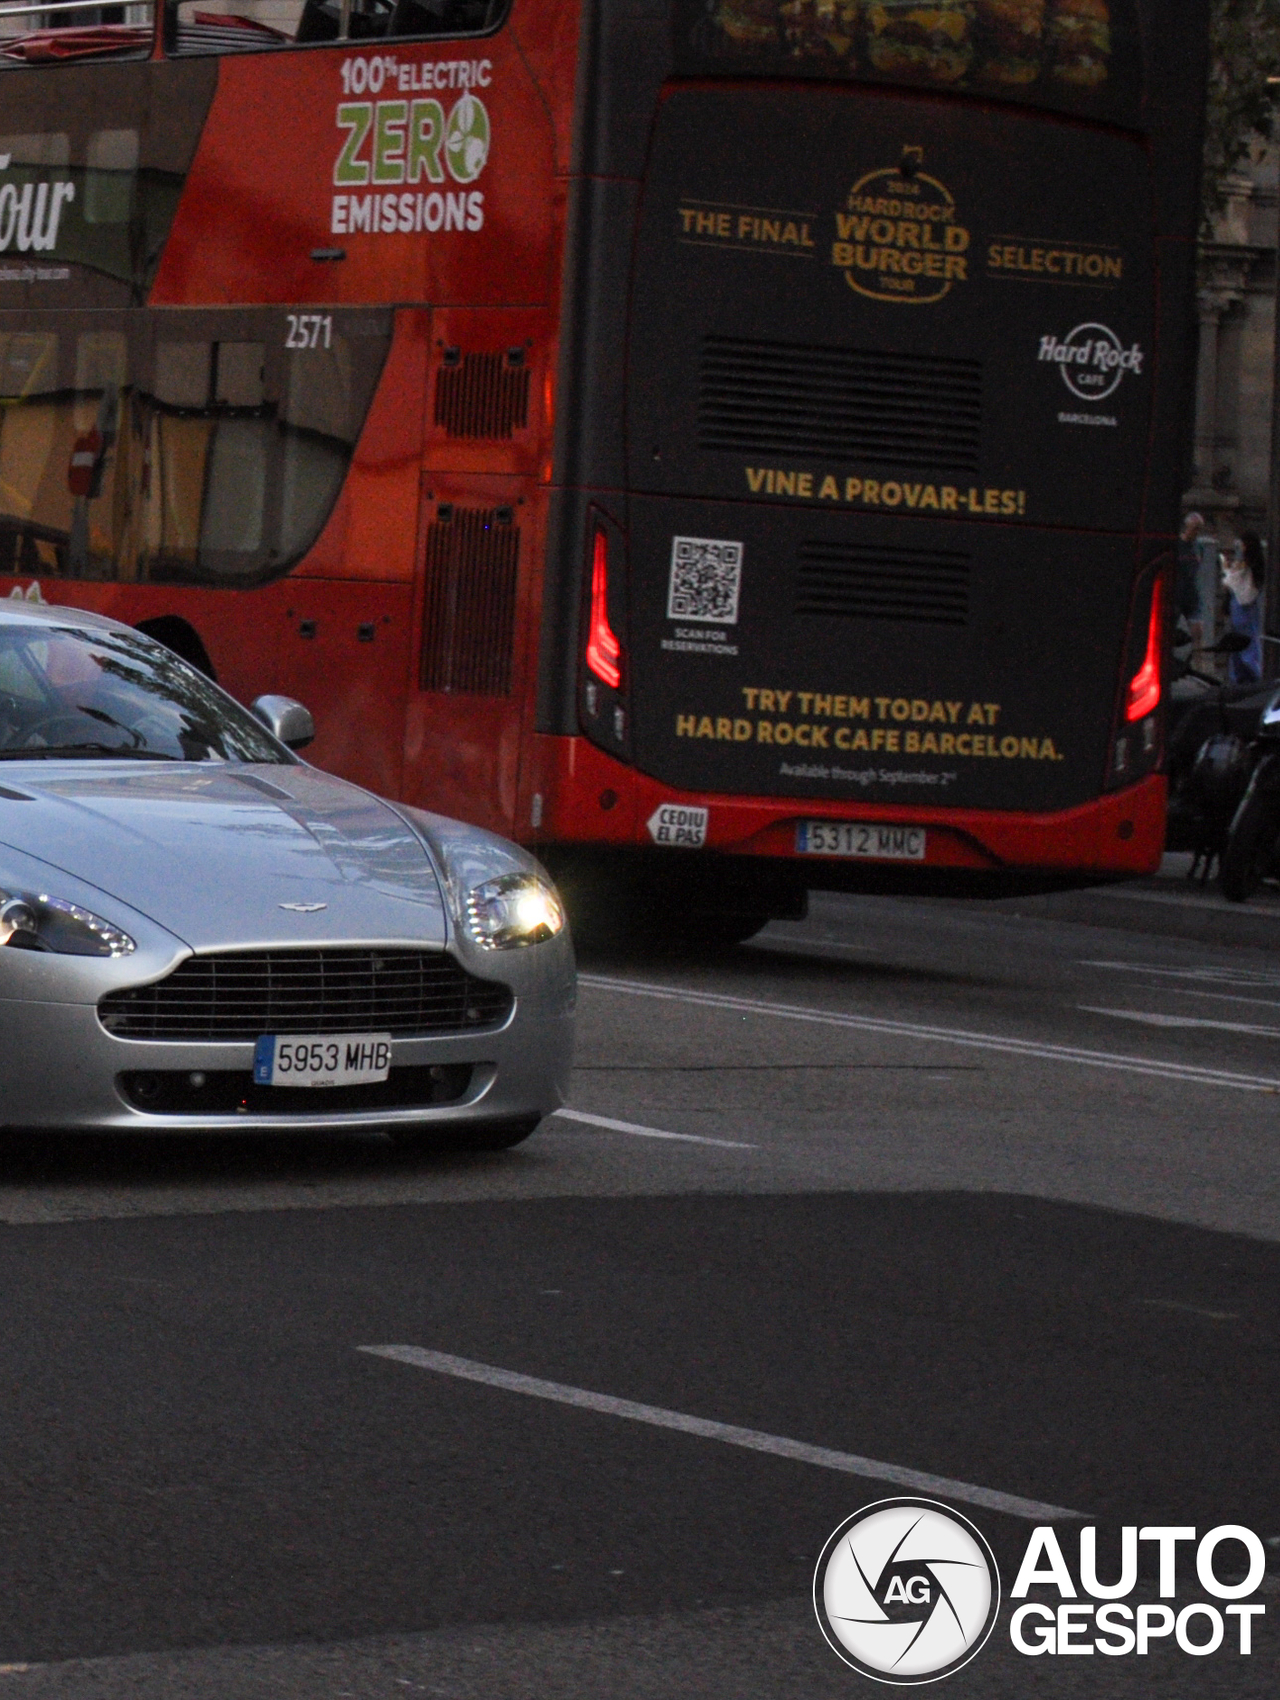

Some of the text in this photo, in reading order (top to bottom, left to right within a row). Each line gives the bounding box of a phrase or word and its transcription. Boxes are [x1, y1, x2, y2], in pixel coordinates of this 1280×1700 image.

[340, 56, 493, 94] 100% ELECTRIC
[333, 93, 491, 187] ZERO
[331, 191, 485, 234] EMISSIONS
[677, 207, 815, 248] THE FINAL
[836, 213, 970, 252] WORLD
[832, 242, 968, 280] BURGER
[987, 243, 1122, 278] SELECTION
[285, 315, 332, 348] 2571
[1038, 335, 1144, 374] Hard Rock
[1077, 373, 1106, 386] CAFE
[745, 467, 1026, 515] VINE A PROVAR-LES!
[660, 639, 739, 656] RESERVATIONS
[674, 628, 727, 642] SCAN FOR
[742, 687, 1001, 726] TRY THEM TODAY AT
[676, 715, 1064, 761] HARD ROCK CAFE BARCELONA.
[779, 763, 830, 778] Available
[831, 766, 877, 786] through
[879, 768, 939, 786] September
[656, 826, 702, 845] EL PAS
[659, 808, 705, 828] CEDIU
[812, 825, 921, 855] 5312 MMC
[278, 1043, 389, 1072] 5953 MHB
